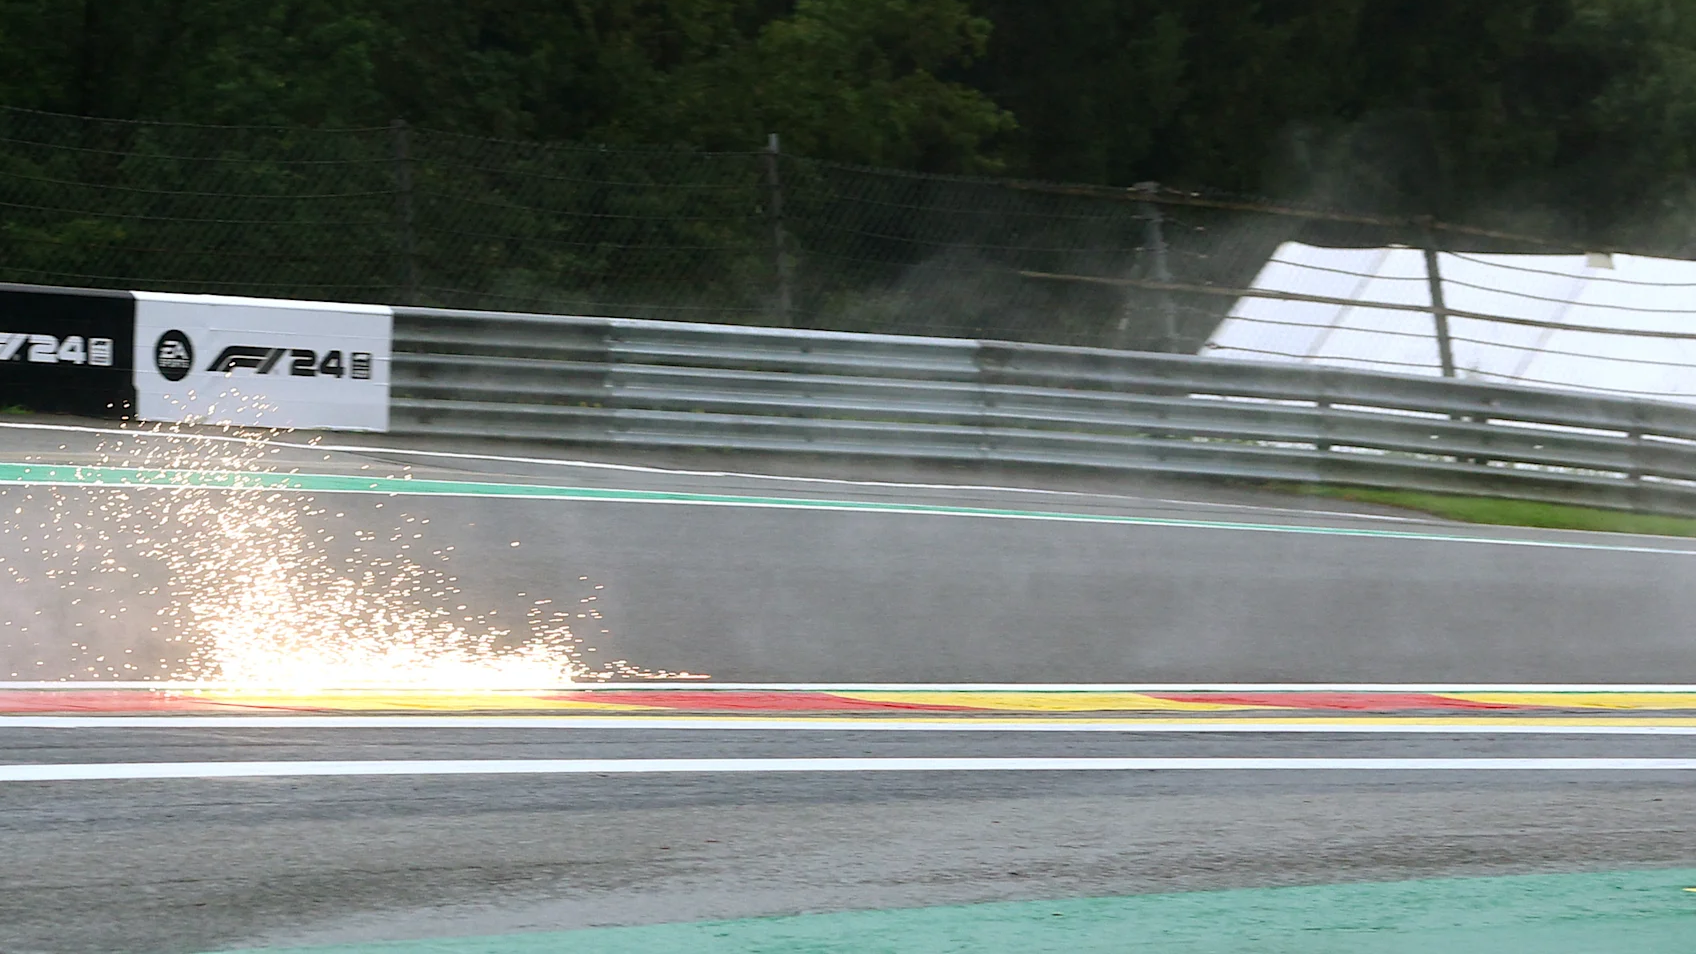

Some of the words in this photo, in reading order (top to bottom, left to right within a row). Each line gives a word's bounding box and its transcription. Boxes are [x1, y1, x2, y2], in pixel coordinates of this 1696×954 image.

[27, 334, 87, 364] 24
[159, 340, 189, 360] EA
[289, 349, 346, 379] 24
